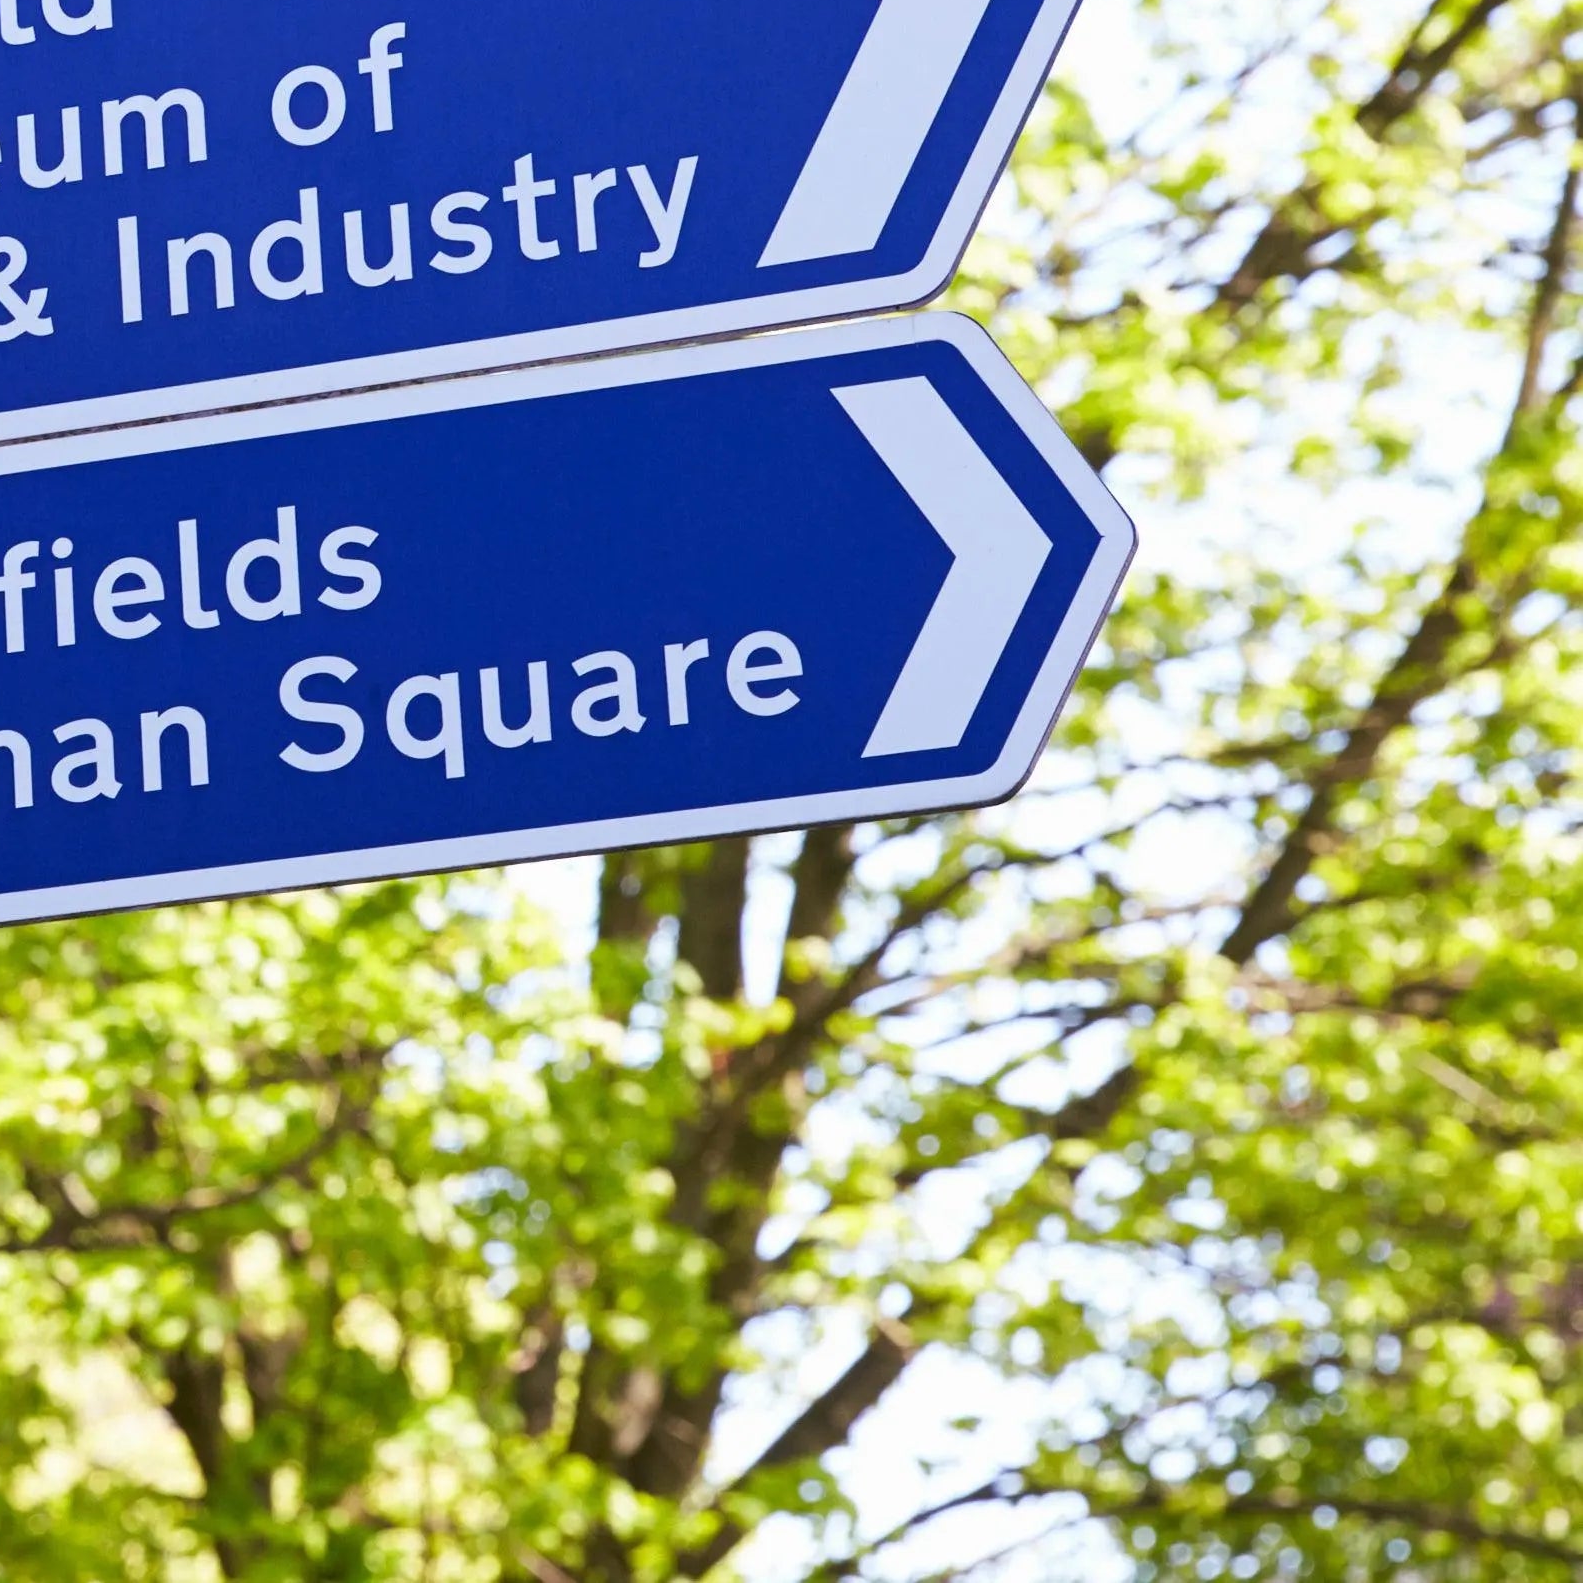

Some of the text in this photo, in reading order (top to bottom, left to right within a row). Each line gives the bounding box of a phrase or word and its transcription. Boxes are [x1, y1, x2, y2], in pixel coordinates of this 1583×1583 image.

[271, 22, 406, 146] of
[117, 152, 699, 324] Industry
[279, 630, 803, 779] Square
